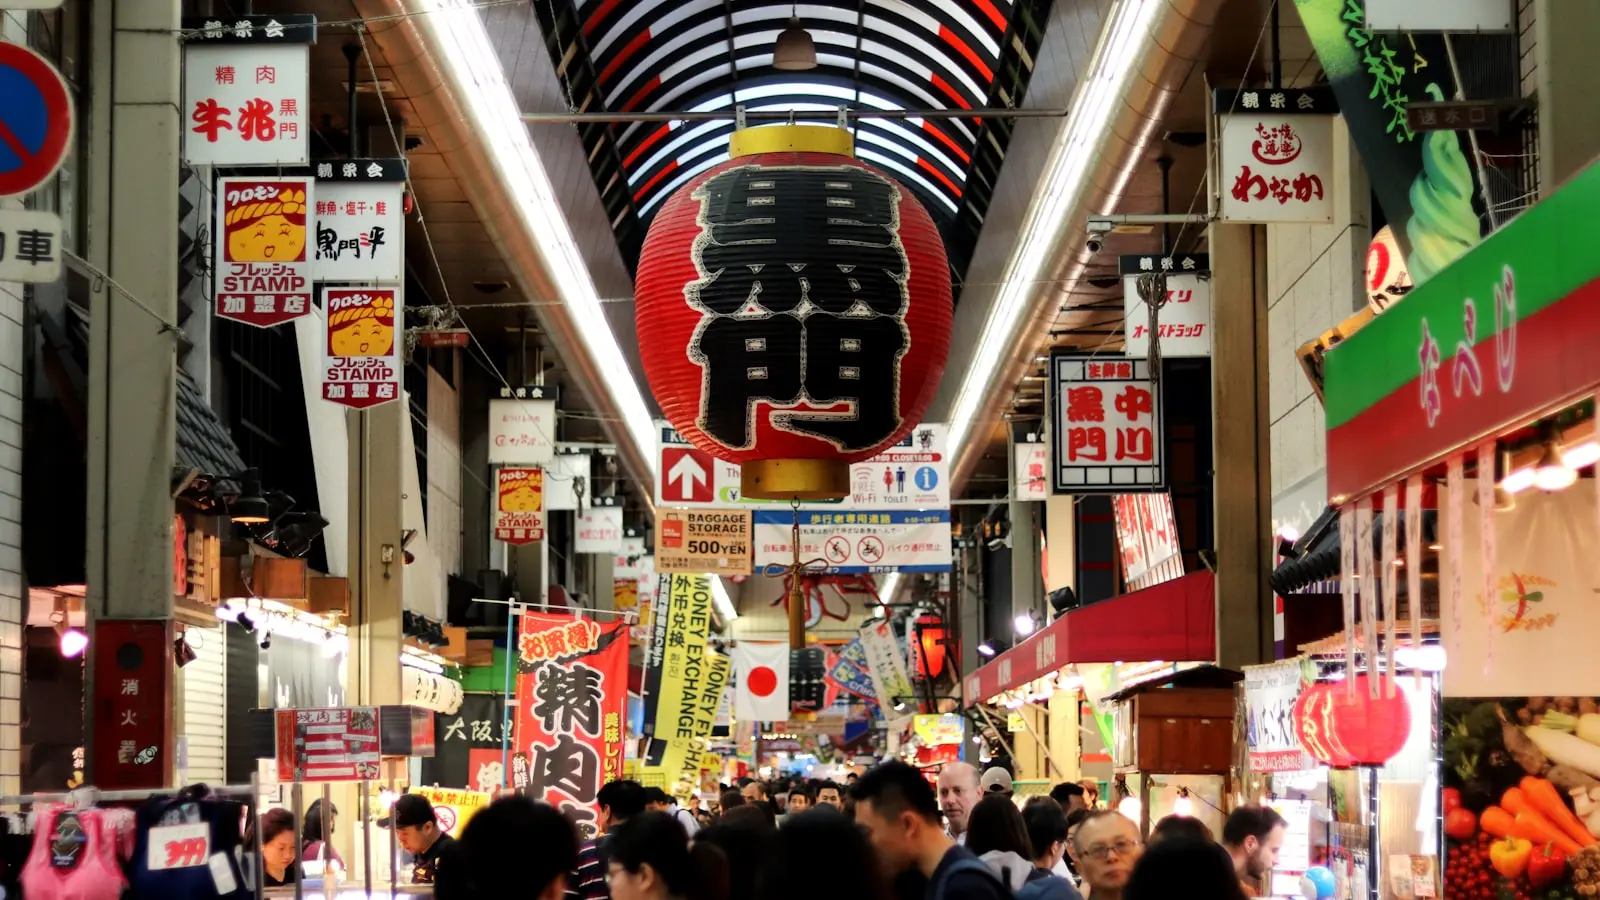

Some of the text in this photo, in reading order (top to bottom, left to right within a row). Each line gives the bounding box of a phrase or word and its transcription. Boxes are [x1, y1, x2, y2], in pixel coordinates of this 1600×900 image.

[215, 65, 277, 86] 精肉
[191, 97, 277, 143] 牛兆
[278, 98, 299, 141] 黒門
[1418, 107, 1487, 127] 送水口
[1231, 165, 1324, 205] わなか
[226, 185, 281, 206] クロモン
[315, 201, 387, 216] 鮮魚・塩干・鮭
[315, 221, 386, 261] 黒門三平
[230, 264, 297, 277] フレッシュ
[223, 276, 306, 292] STAMP
[223, 295, 306, 314] 加盟店
[329, 293, 374, 311] クロモン
[683, 165, 910, 450] 黒門
[1132, 323, 1206, 339] オースドラッグ
[332, 357, 387, 368] フレッシュ
[327, 368, 394, 381] STAMP
[327, 383, 394, 399] 加盟店
[852, 494, 877, 504] Wi-Fi
[498, 519, 541, 528] STAMP
[687, 514, 746, 524] BAGGAGE
[687, 523, 746, 533] STORAGE
[687, 540, 746, 555] 500 YEN
[668, 575, 692, 649] 外币兑换
[520, 621, 601, 663] お買得!
[676, 577, 710, 740] MONEY EXCHANGE
[702, 657, 729, 717] MONEY
[118, 678, 139, 765] 消火器
